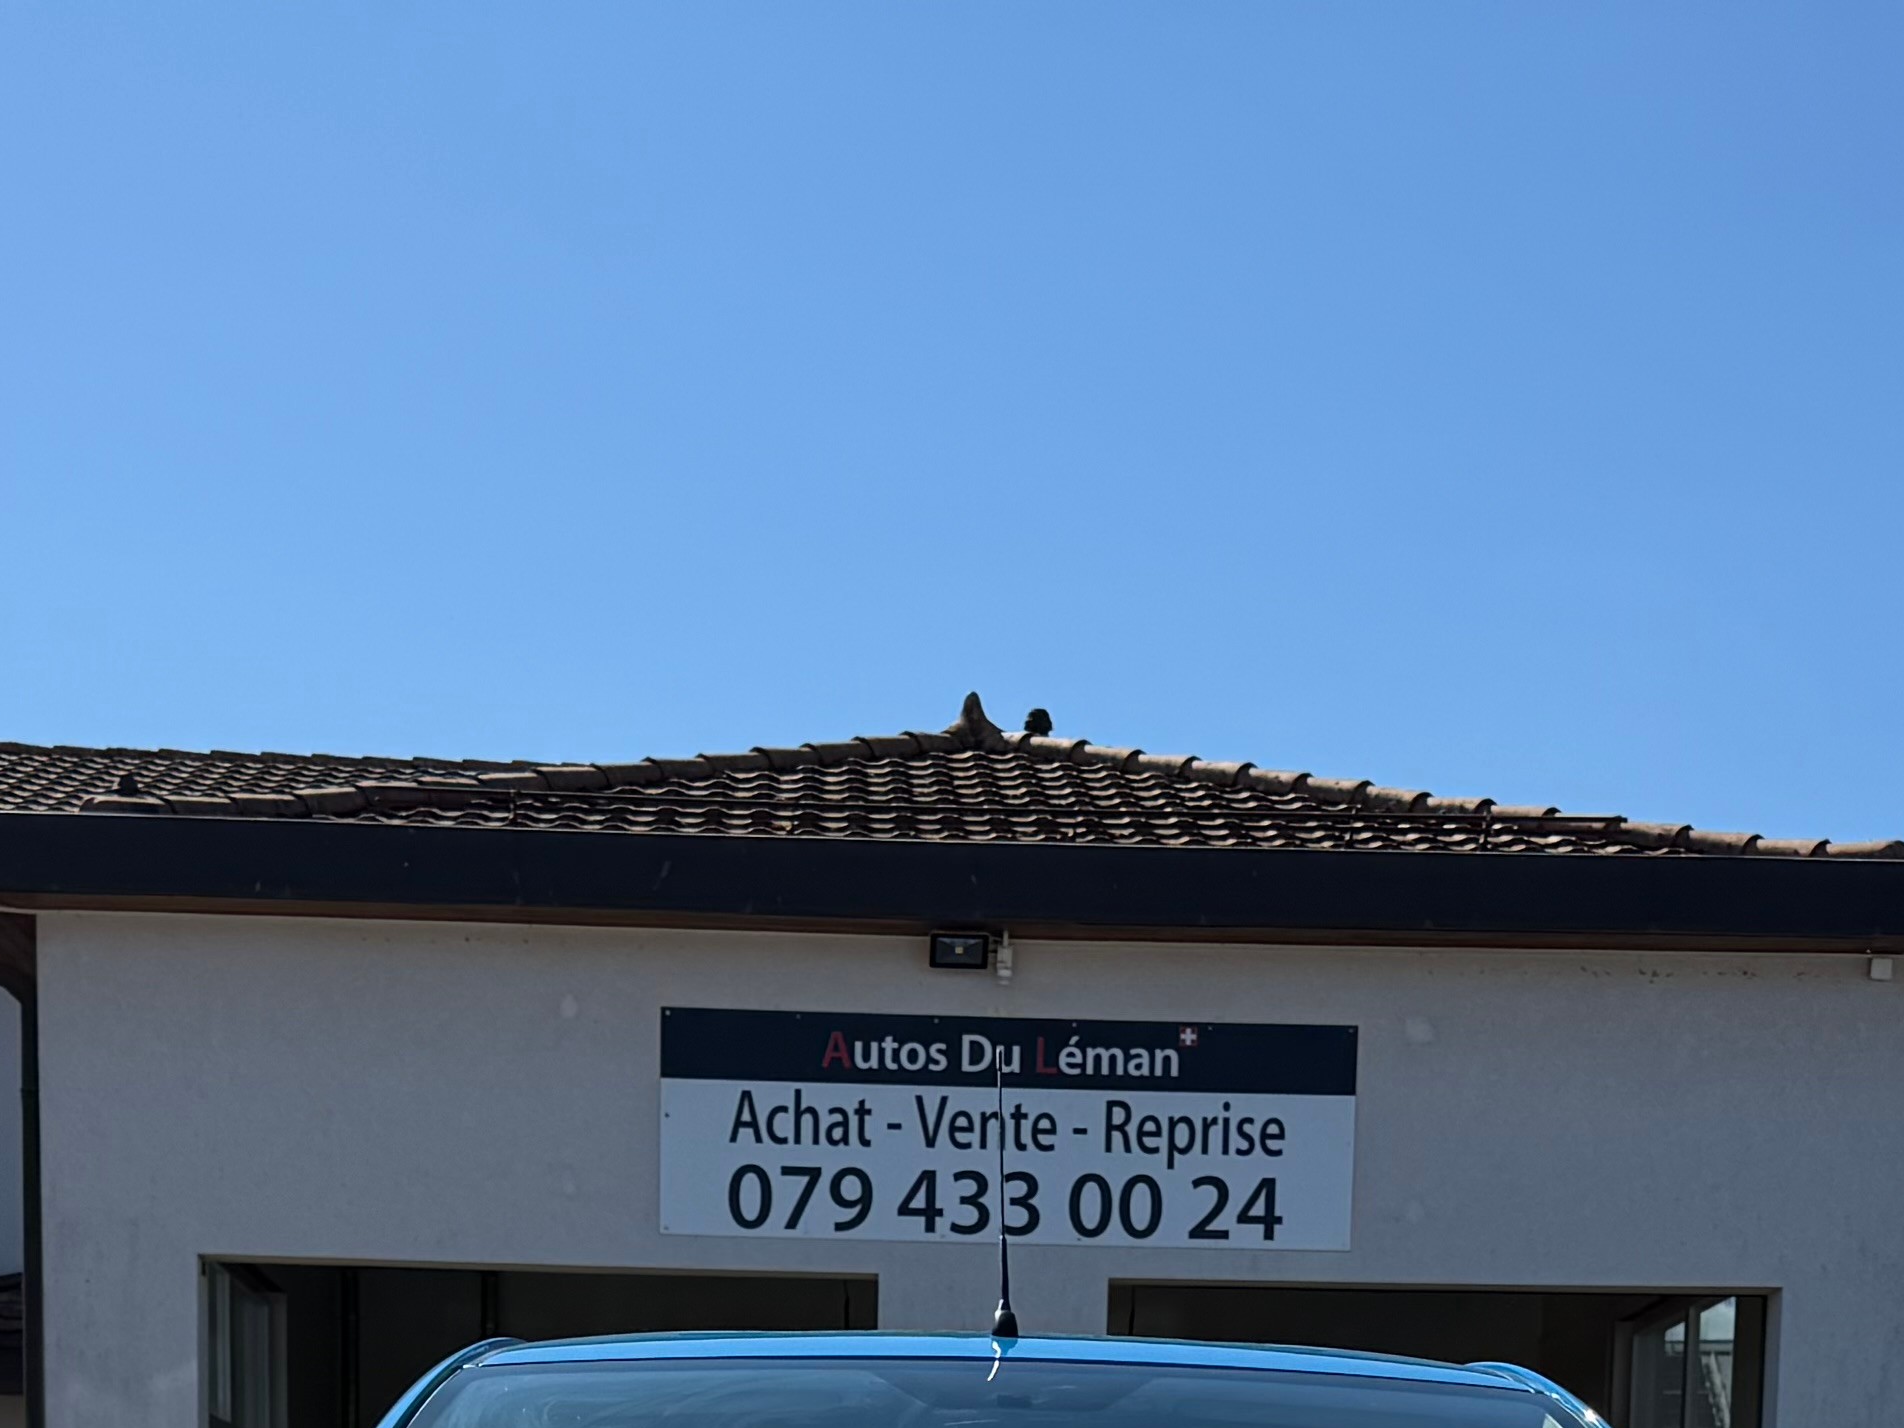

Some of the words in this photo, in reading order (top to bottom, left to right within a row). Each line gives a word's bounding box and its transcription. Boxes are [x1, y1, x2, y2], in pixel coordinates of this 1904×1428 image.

[821, 1031, 949, 1072] Autos
[961, 1034, 1022, 1074] Du
[1035, 1035, 1180, 1078] Léman
[728, 1088, 873, 1148] Achat
[914, 1094, 1058, 1153] Vente
[1104, 1099, 1286, 1170] Reprise
[727, 1163, 874, 1233] 079
[897, 1169, 1040, 1237] 433
[1068, 1172, 1163, 1240] 00
[1188, 1175, 1284, 1241] 24
